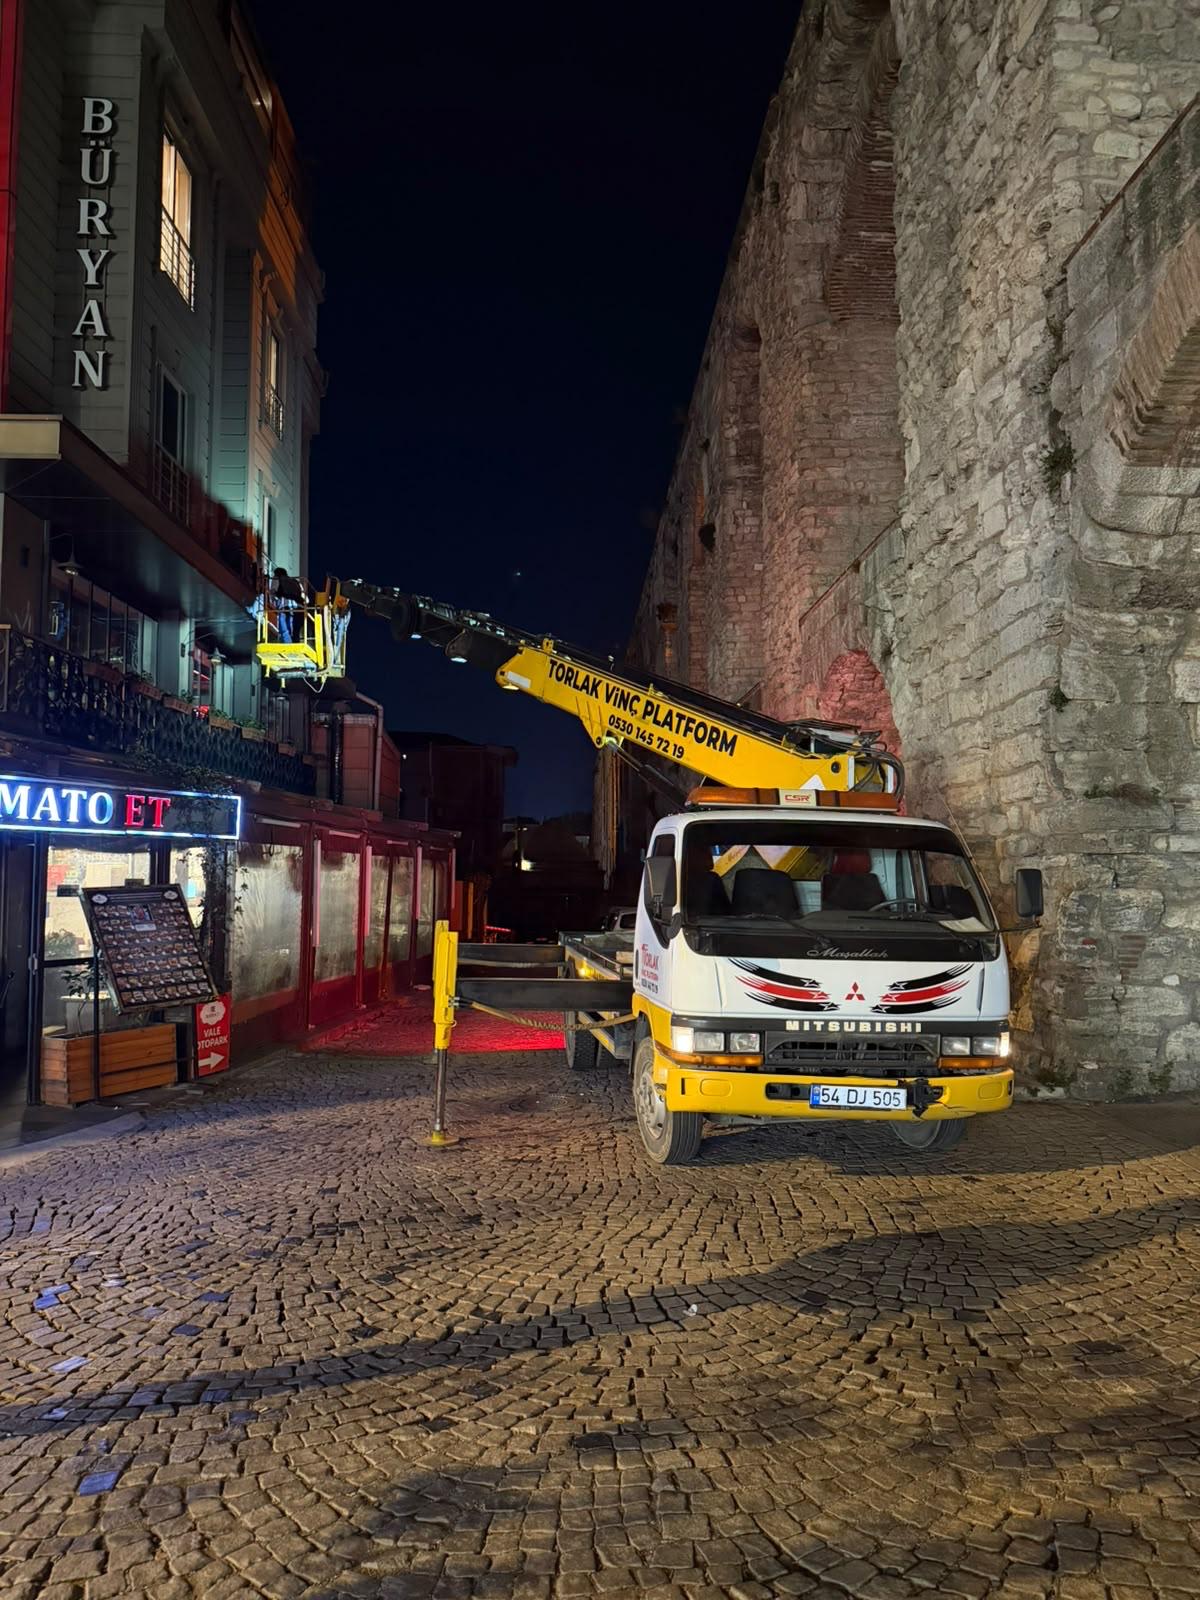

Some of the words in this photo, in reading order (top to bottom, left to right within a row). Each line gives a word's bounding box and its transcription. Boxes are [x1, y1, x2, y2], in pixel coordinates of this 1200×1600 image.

[72, 97, 113, 387] BÜRYAN
[549, 659, 603, 699] TORLAK
[642, 700, 738, 757] PLATFORM
[608, 714, 633, 735] 0530
[635, 726, 654, 746] 145
[656, 736, 670, 753] 72
[672, 743, 685, 759] 19
[0, 783, 114, 825] MATO
[124, 794, 171, 829] ET
[203, 1026, 221, 1038] VALE
[785, 1020, 922, 1033] MITSUBISHI
[821, 1087, 840, 1103] 54
[846, 1089, 867, 1105] DJ
[873, 1091, 901, 1107] 505
